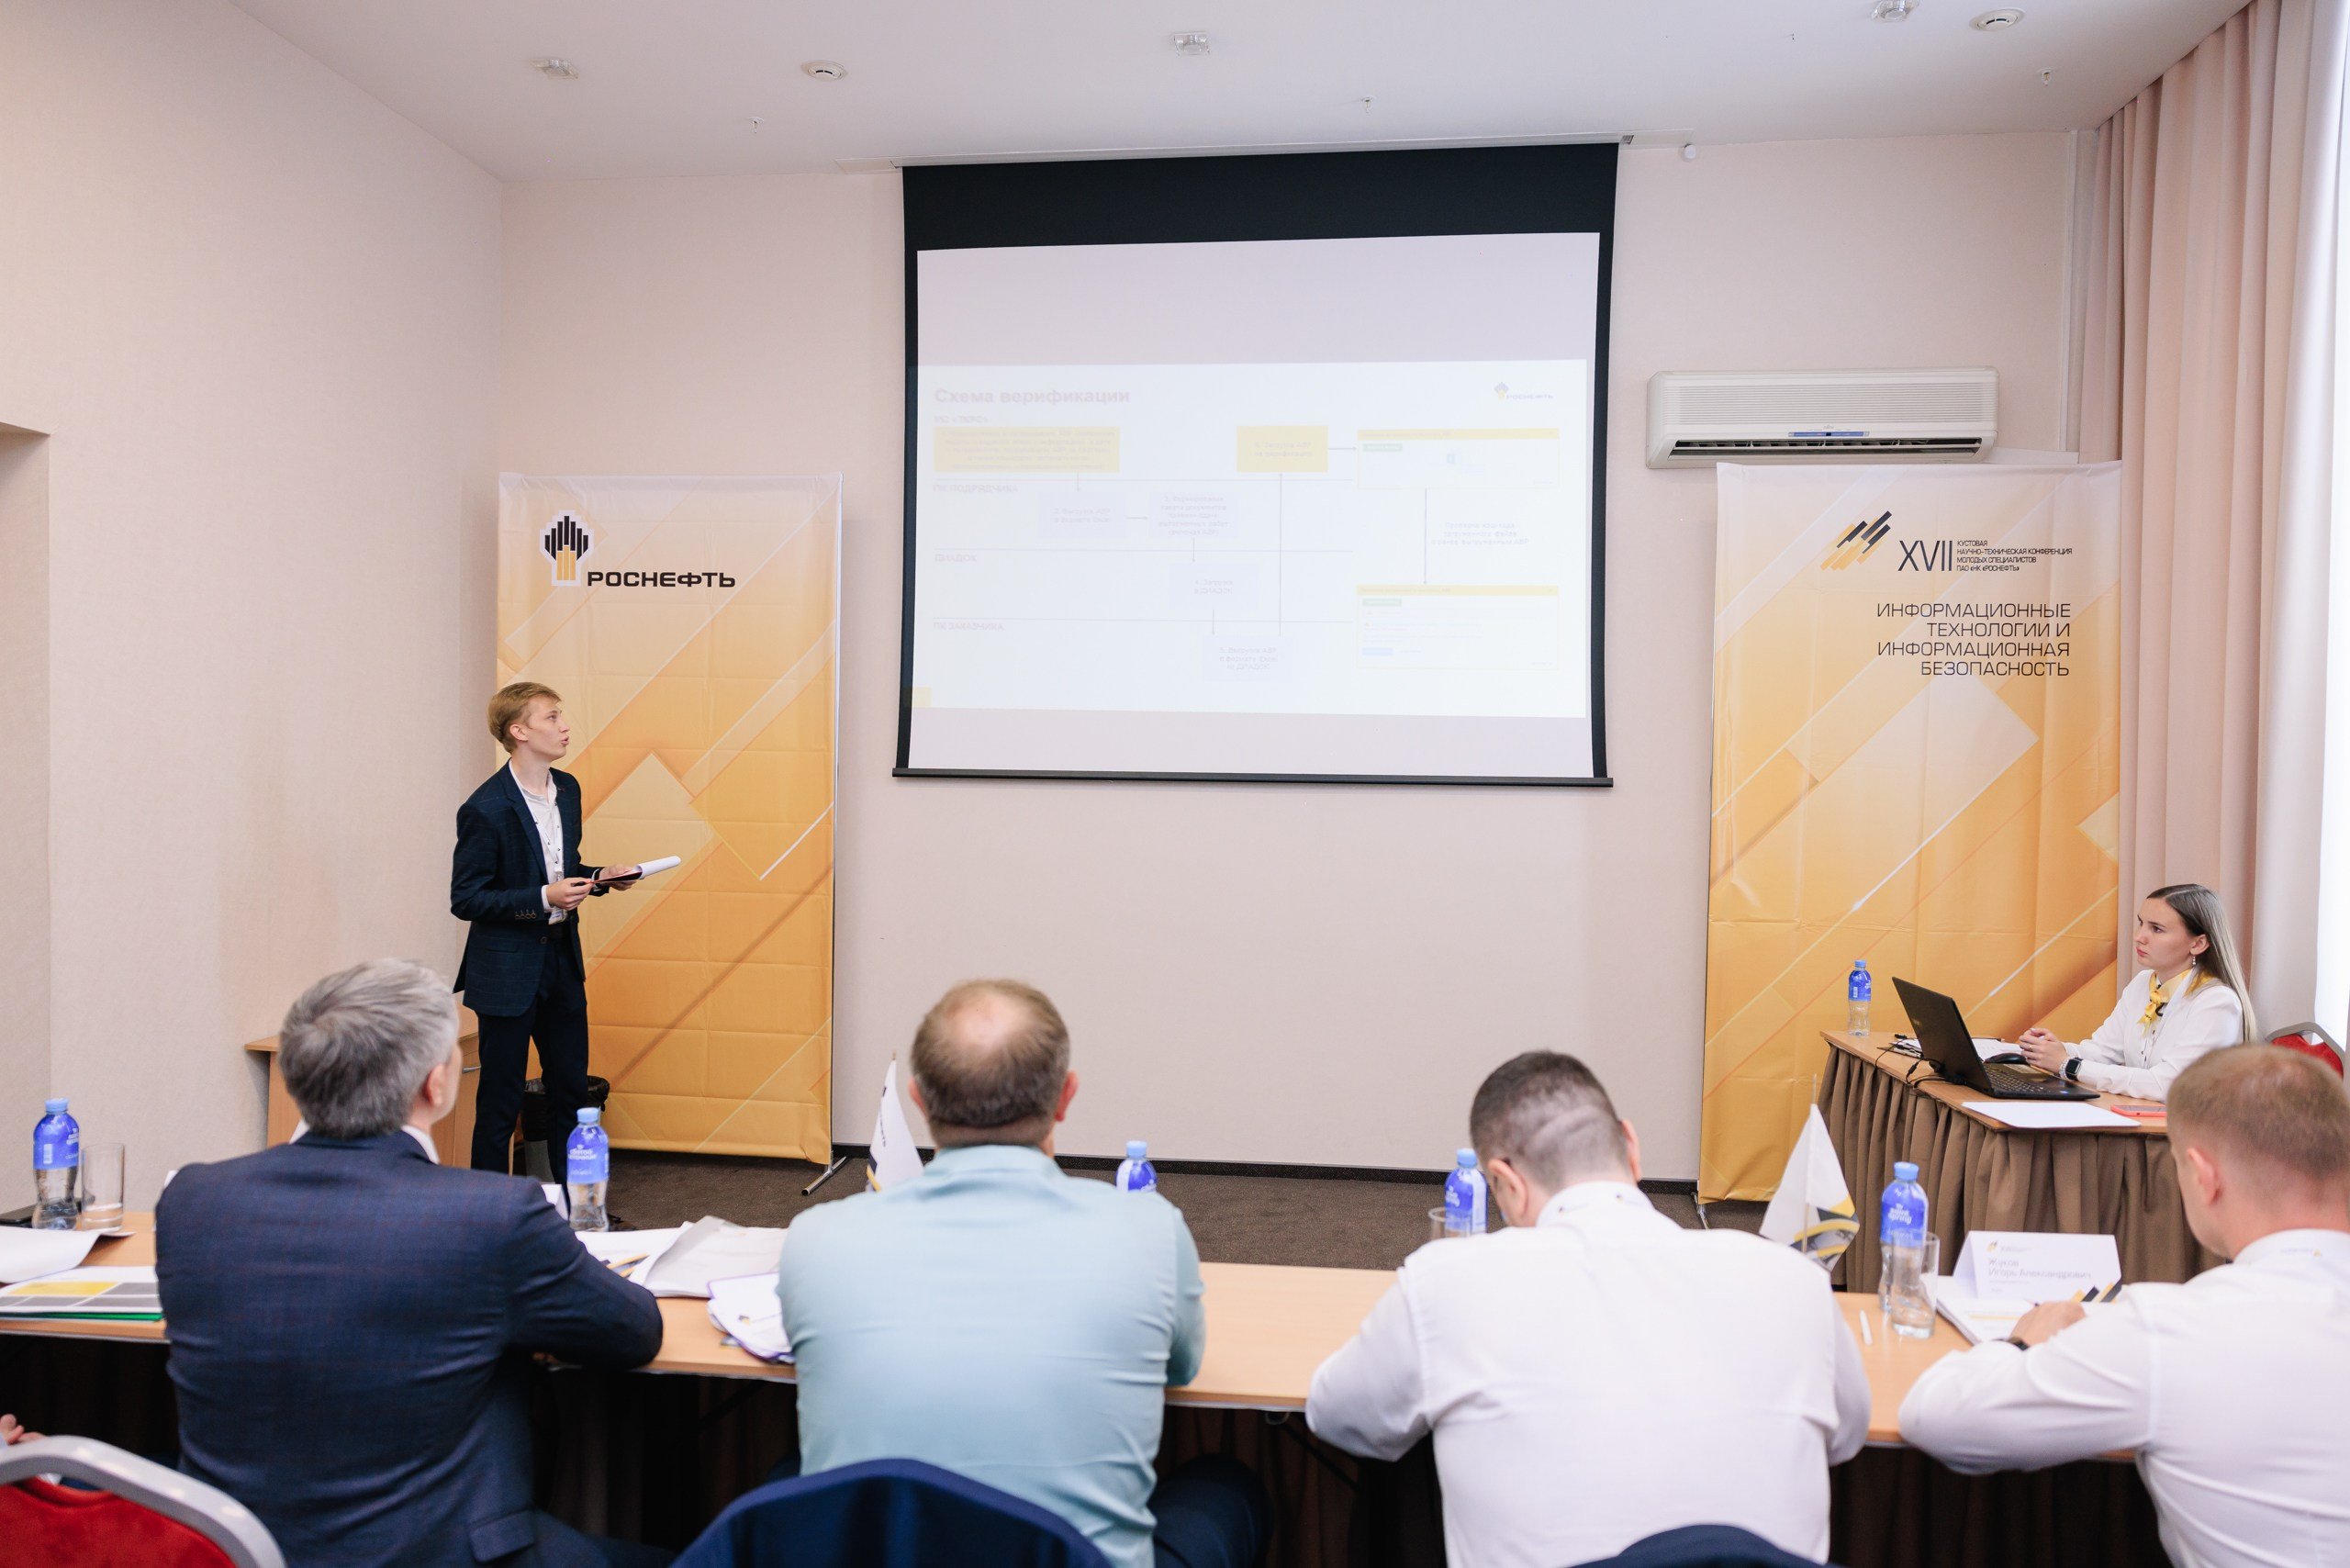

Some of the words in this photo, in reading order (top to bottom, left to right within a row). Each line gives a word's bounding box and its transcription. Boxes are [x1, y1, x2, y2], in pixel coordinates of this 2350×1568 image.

[934, 389, 994, 403] Схема
[1000, 389, 1129, 406] верификации
[1897, 540, 1953, 572] XVII
[588, 571, 736, 588] РОСНЕФТЬ
[1876, 603, 2071, 621] ИНФОРМАЦИОННЫЕ
[1927, 622, 2051, 637] ТЕХНОЛОГИИ
[2056, 622, 2071, 637] И
[1878, 642, 2070, 659] ИНФОРМАЦИОННАЯ
[1921, 661, 2070, 677] БЕЗОПАСНОСТЬ
